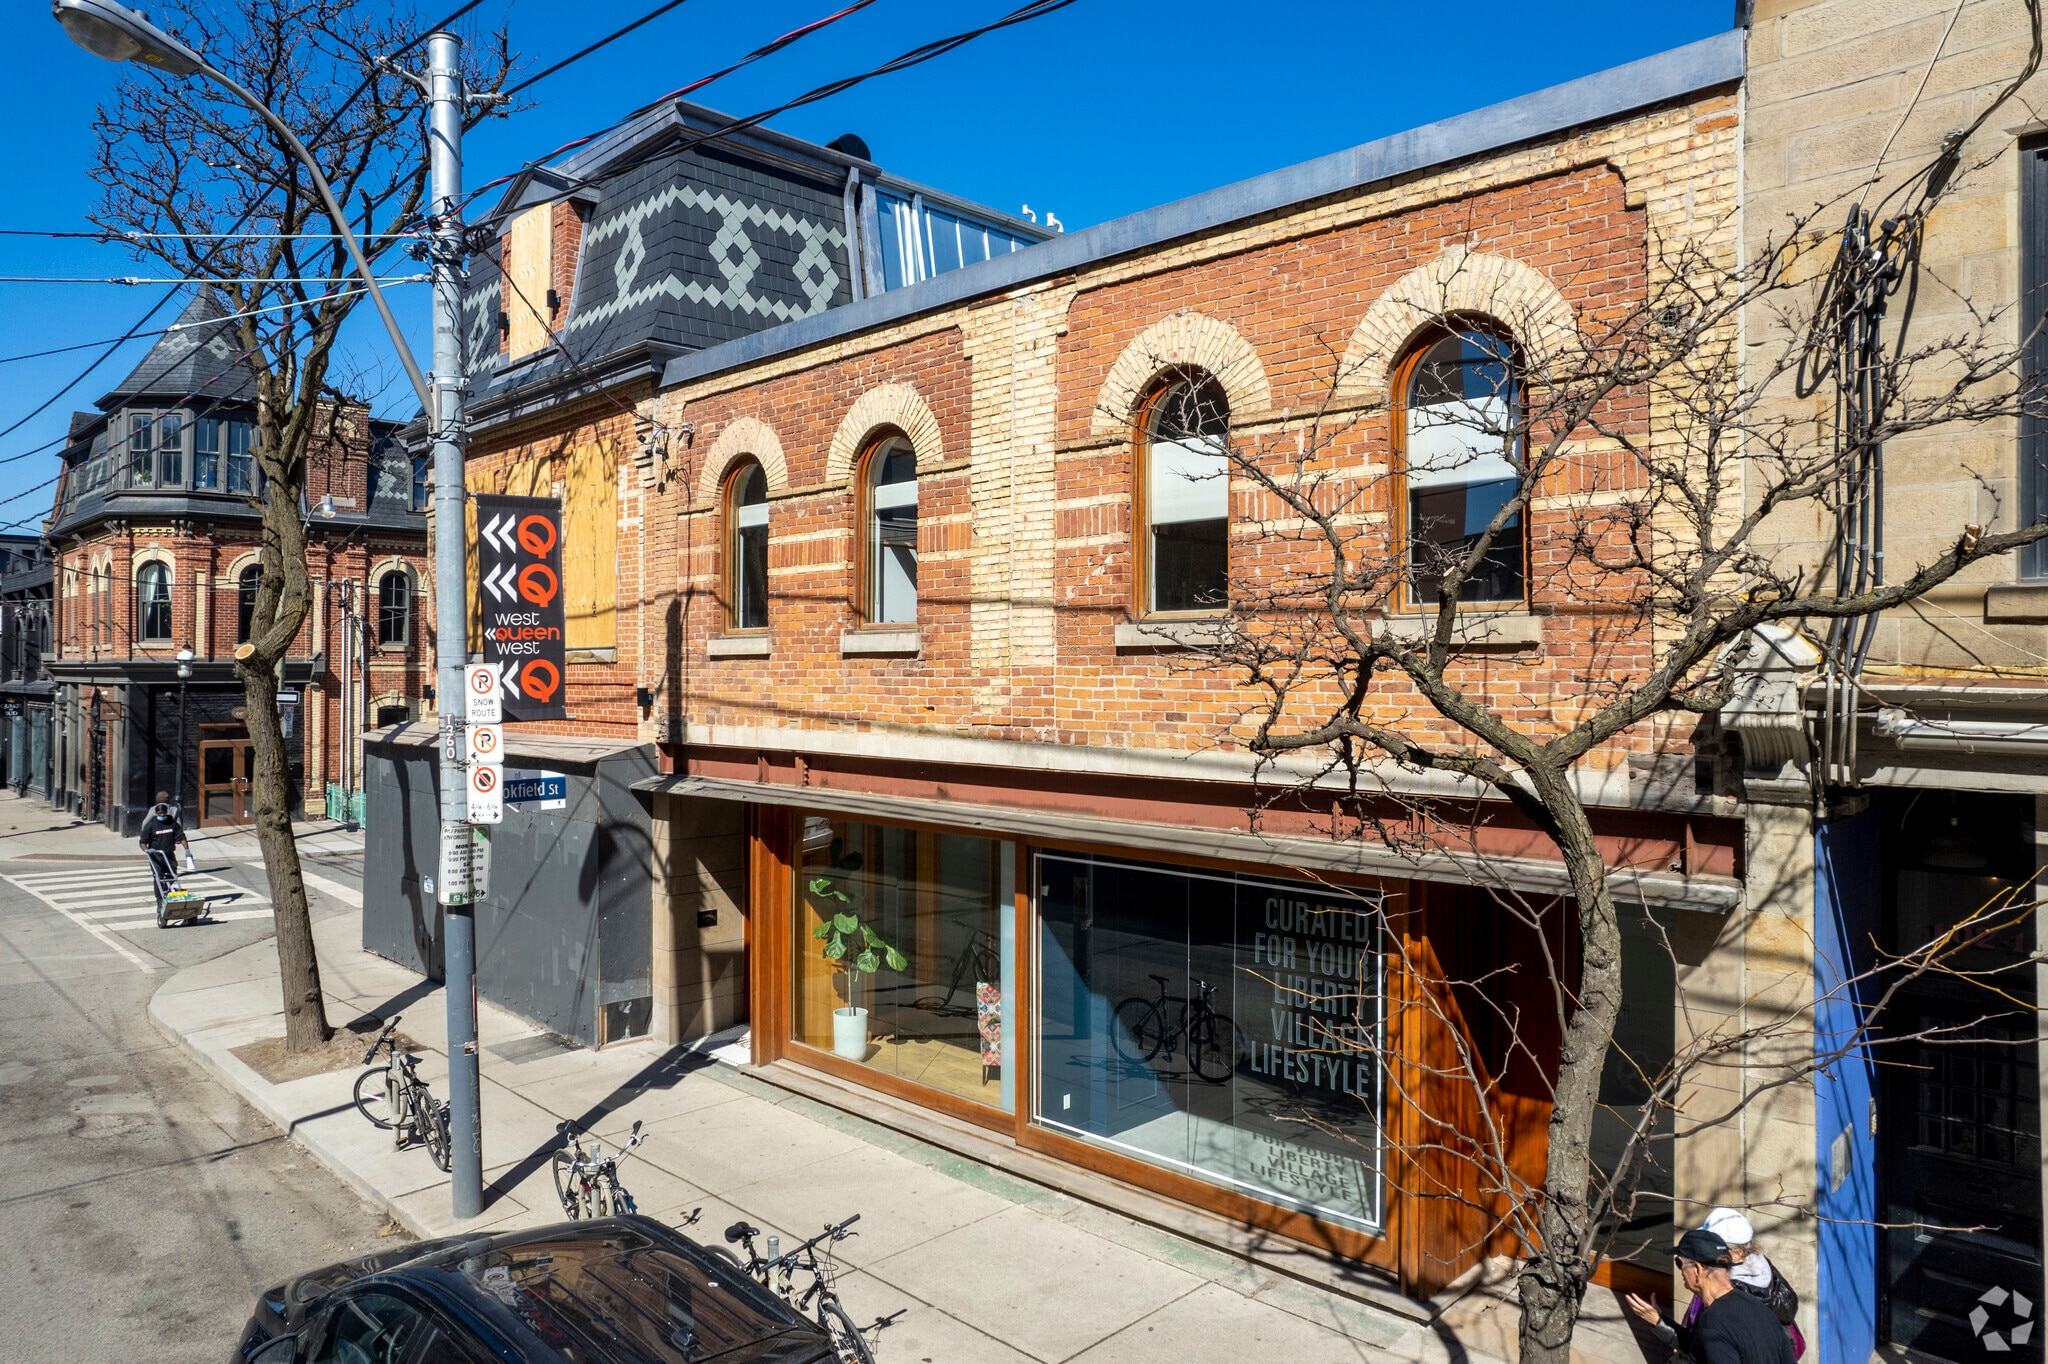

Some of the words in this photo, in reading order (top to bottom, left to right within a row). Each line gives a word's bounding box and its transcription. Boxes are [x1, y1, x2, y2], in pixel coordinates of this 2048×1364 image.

[495, 612, 540, 626] west
[495, 641, 540, 655] west
[471, 708, 496, 718] ROUTE
[473, 698, 494, 707] SNOW
[548, 783, 559, 796] St
[1265, 898, 1370, 943] CURATED
[1254, 932, 1296, 969] FOR
[1305, 939, 1369, 982] YOUR
[1273, 972, 1369, 1020] LIBERTY
[1270, 1007, 1369, 1060] VILLAGE
[1251, 1040, 1369, 1098] LIFESTYLE
[1267, 1156, 1350, 1189] VILLAGE
[1269, 1146, 1346, 1175] LIBERTY
[1250, 1162, 1352, 1203] LIFESTYLE
